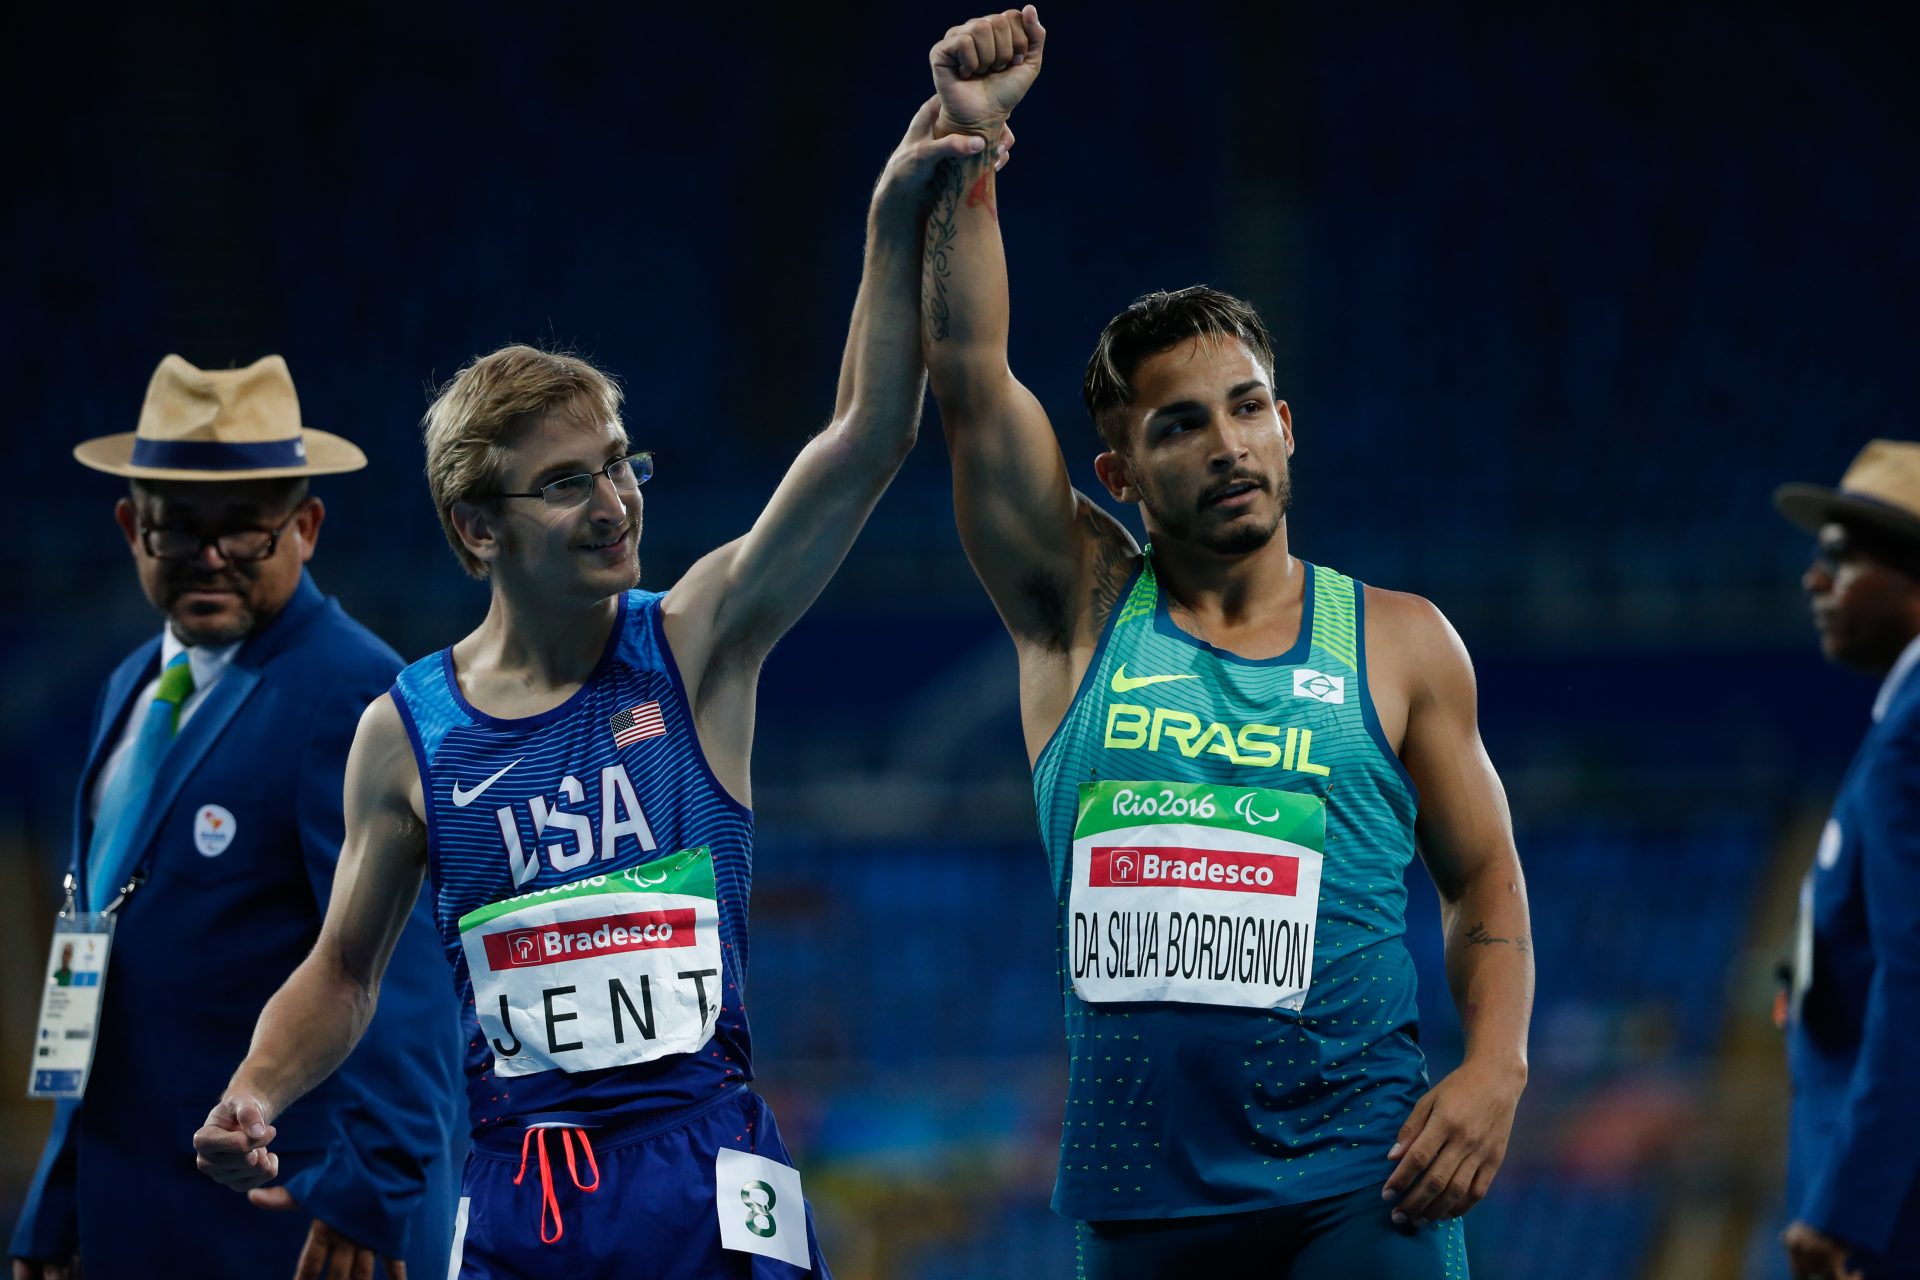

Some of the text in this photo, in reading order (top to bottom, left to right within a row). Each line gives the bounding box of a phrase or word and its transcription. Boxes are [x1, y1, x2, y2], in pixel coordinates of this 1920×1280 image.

[1104, 703, 1331, 777] BRASIL
[497, 763, 657, 890] USA
[1142, 854, 1274, 887] Bradesco
[543, 922, 673, 957] Bradesco
[1074, 911, 1309, 990] DA SILVA BORDIGNON
[492, 968, 718, 1057] JENT
[740, 1180, 777, 1238] 8
